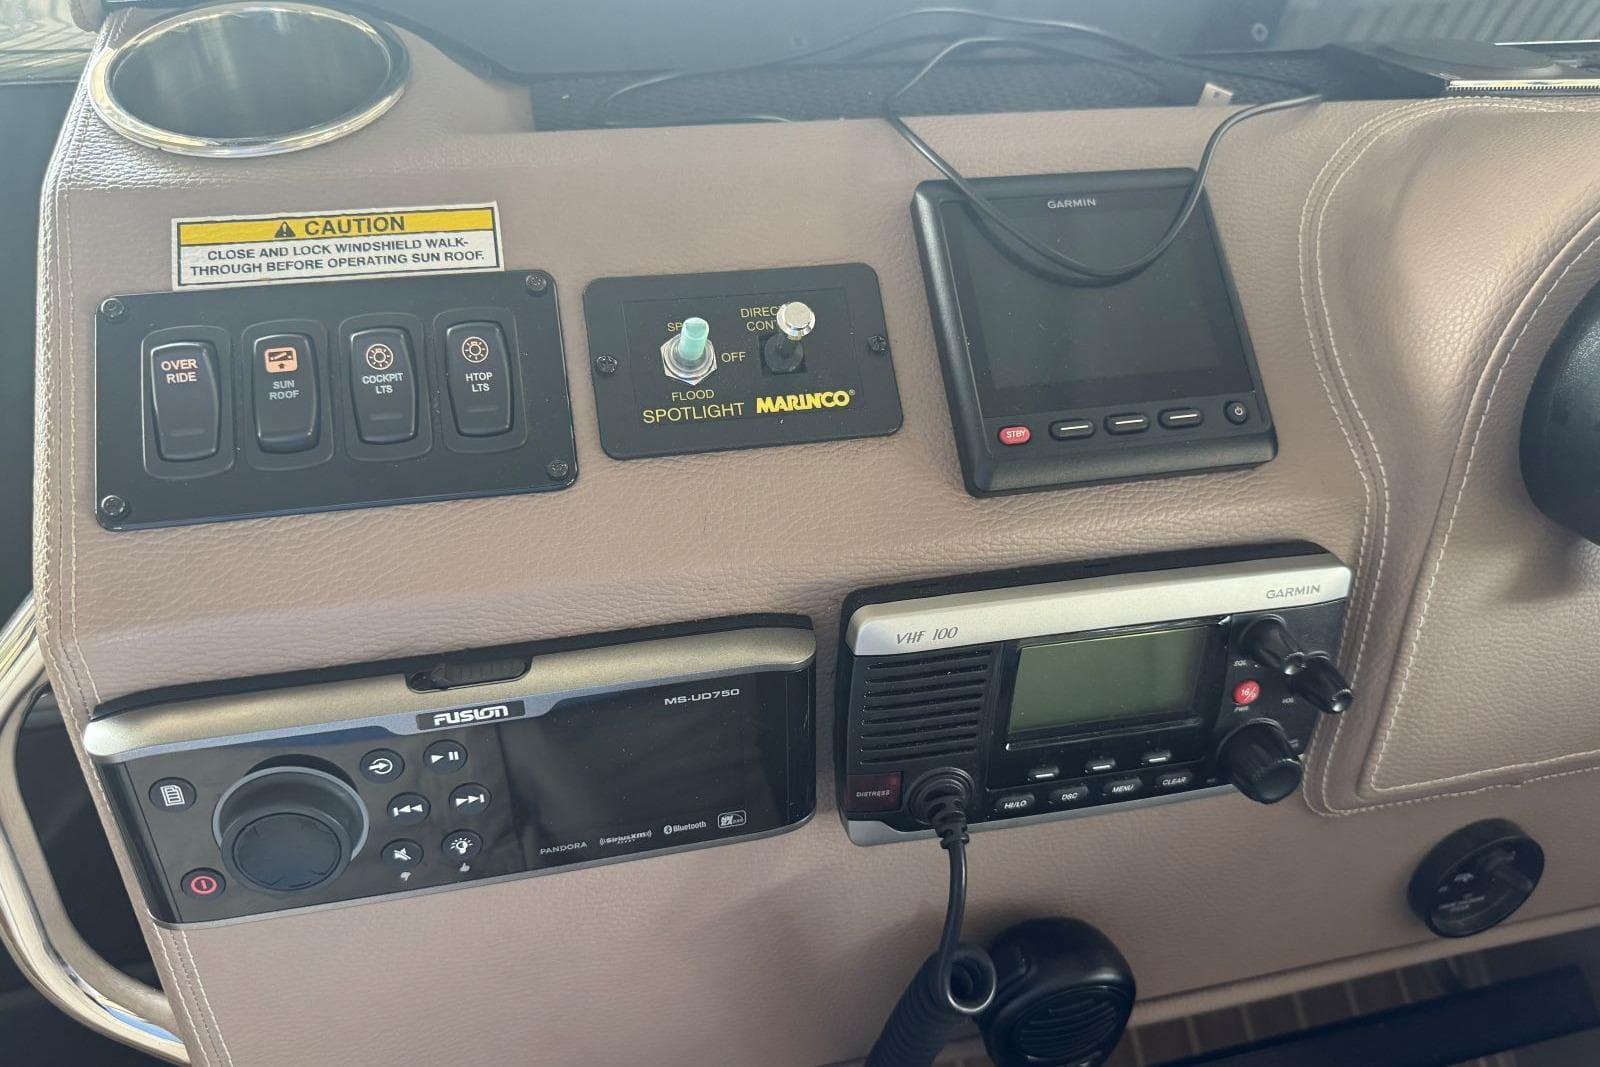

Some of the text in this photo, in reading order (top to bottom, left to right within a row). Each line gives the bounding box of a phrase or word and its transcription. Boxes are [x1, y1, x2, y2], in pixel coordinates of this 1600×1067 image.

[1047, 198, 1096, 209] GARMIN
[305, 215, 405, 236] CAUTION
[207, 237, 469, 261] CLOSE AND LOCK WINDSHIELD WALK-
[190, 249, 485, 277] THROUGH BEFORE OPERATING SUN ROOF.
[667, 322, 683, 332] SP
[721, 351, 747, 363] OFF
[160, 358, 198, 371] OVER
[165, 371, 197, 384] RIDE
[362, 372, 403, 386] COCKPIT
[465, 371, 493, 383] HTOP
[272, 379, 295, 390] SUN
[375, 384, 393, 395] LTS
[471, 382, 490, 394] LTS
[269, 389, 300, 401] ROOF
[671, 389, 715, 402] FLOOD
[643, 402, 745, 424] SPOTLIGHT
[1005, 428, 1026, 440] STBY
[1265, 583, 1321, 601] GARMIN
[896, 626, 958, 645] VHF 100
[664, 687, 740, 706] MS-UD750
[433, 704, 509, 727] FUSION
[1162, 776, 1187, 786] CLEAR
[856, 789, 891, 799] DISTRESS
[1112, 783, 1134, 793] MENU
[1061, 792, 1079, 802] DSC
[1004, 799, 1027, 810] HI/LO
[673, 821, 706, 833] Bluetooth
[540, 841, 588, 855] PANDORA
